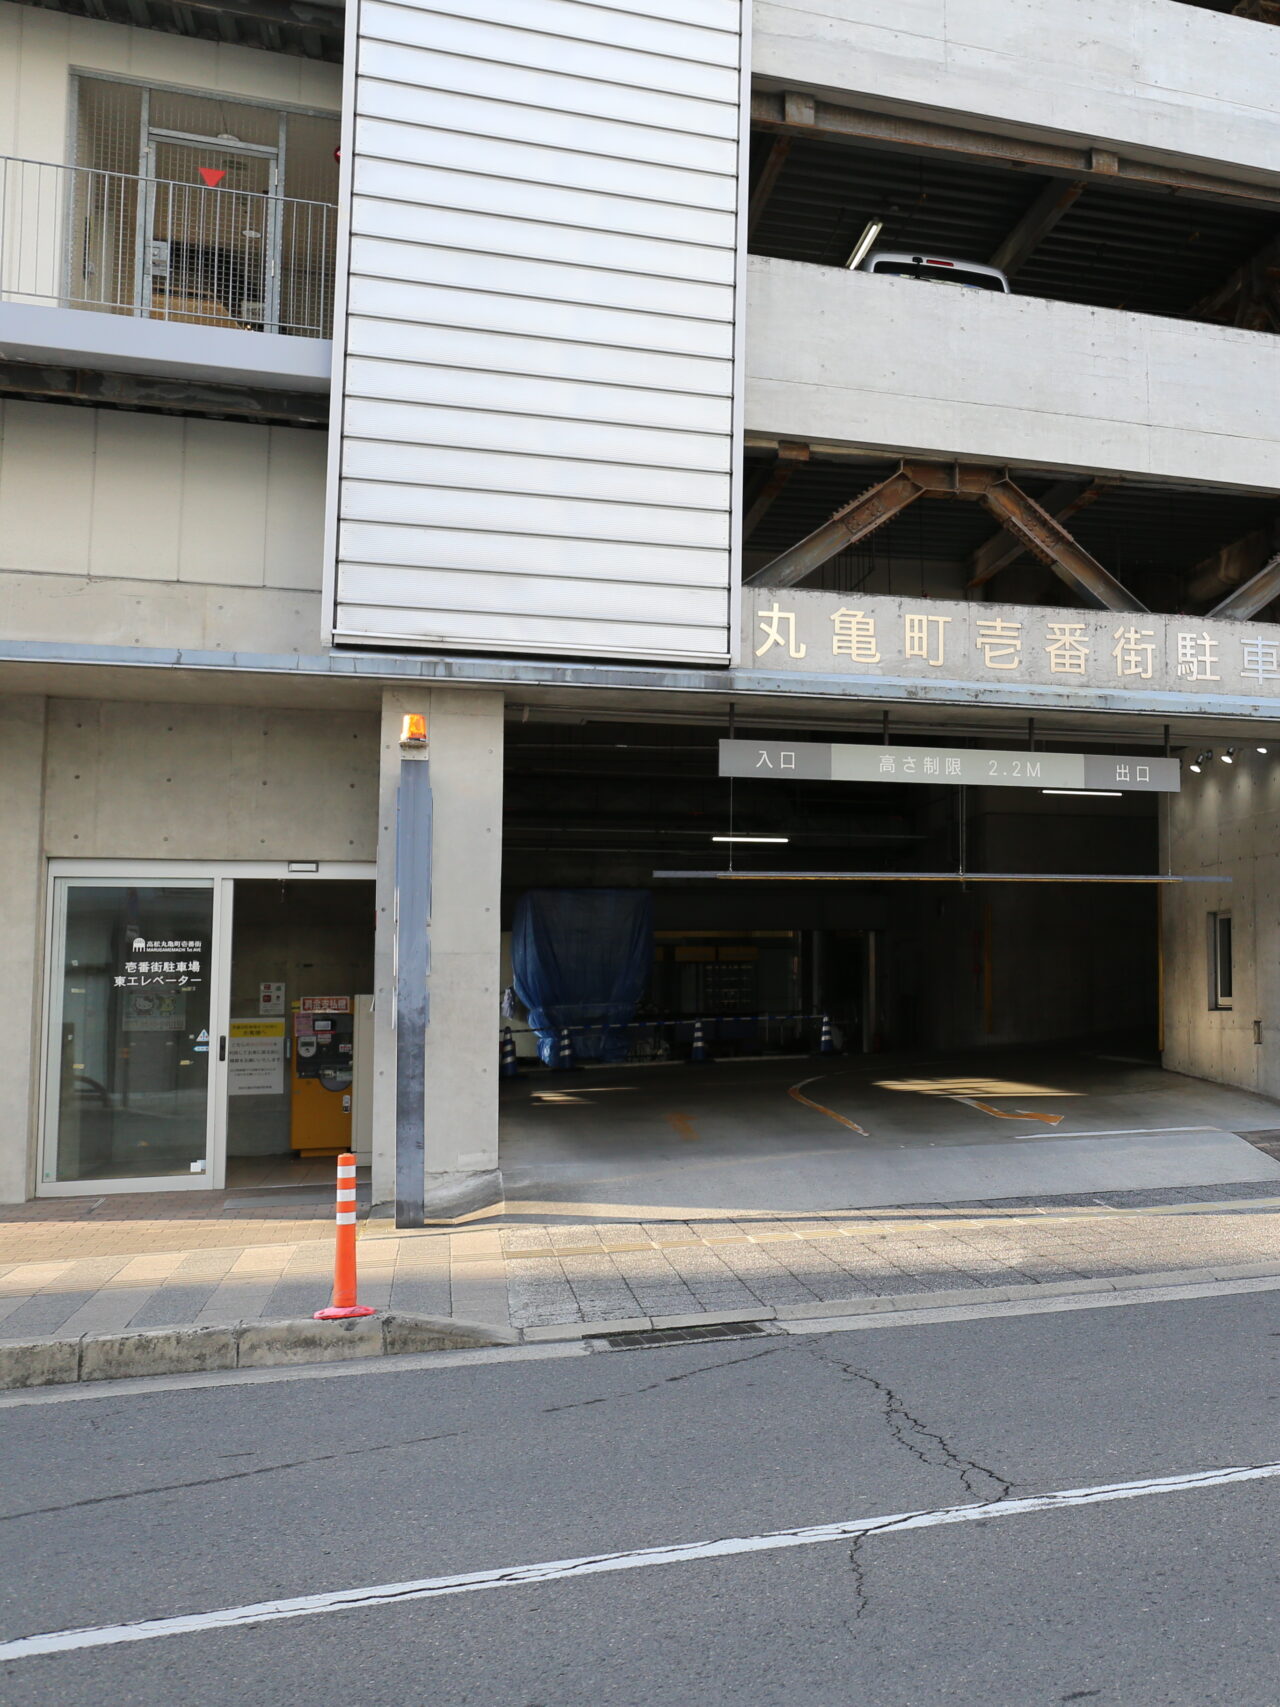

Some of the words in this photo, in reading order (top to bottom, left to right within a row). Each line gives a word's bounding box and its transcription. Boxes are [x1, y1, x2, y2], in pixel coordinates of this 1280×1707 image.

[756, 749, 796, 770] 入口
[878, 754, 962, 777] 高さ制限
[989, 759, 1041, 778] 2.2M
[1115, 763, 1151, 783] 出口
[125, 960, 201, 973] 壱番街駐車場
[113, 975, 202, 987] 東エレベーター
